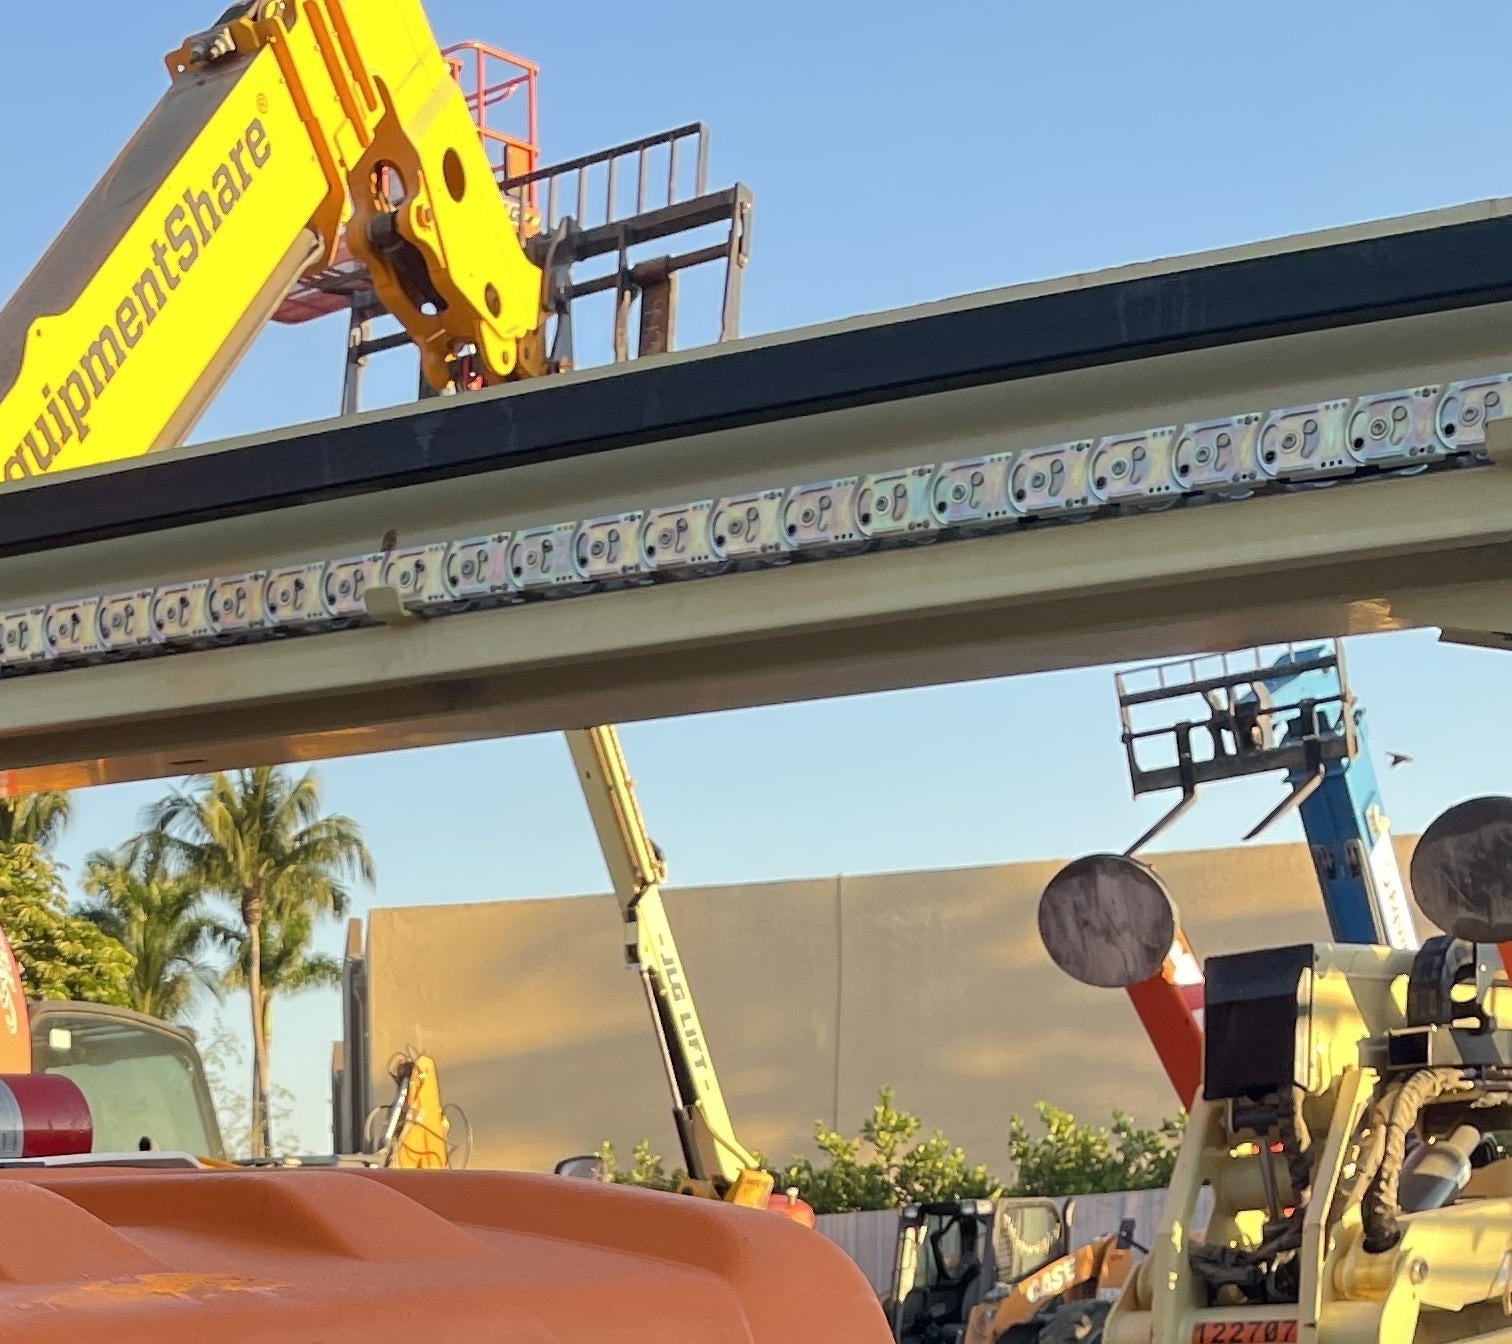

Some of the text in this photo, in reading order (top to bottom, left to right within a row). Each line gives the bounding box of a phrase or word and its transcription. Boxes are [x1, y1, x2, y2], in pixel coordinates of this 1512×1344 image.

[661, 953, 707, 1069] JLG LIFT
[1025, 1256, 1076, 1303] CASE
